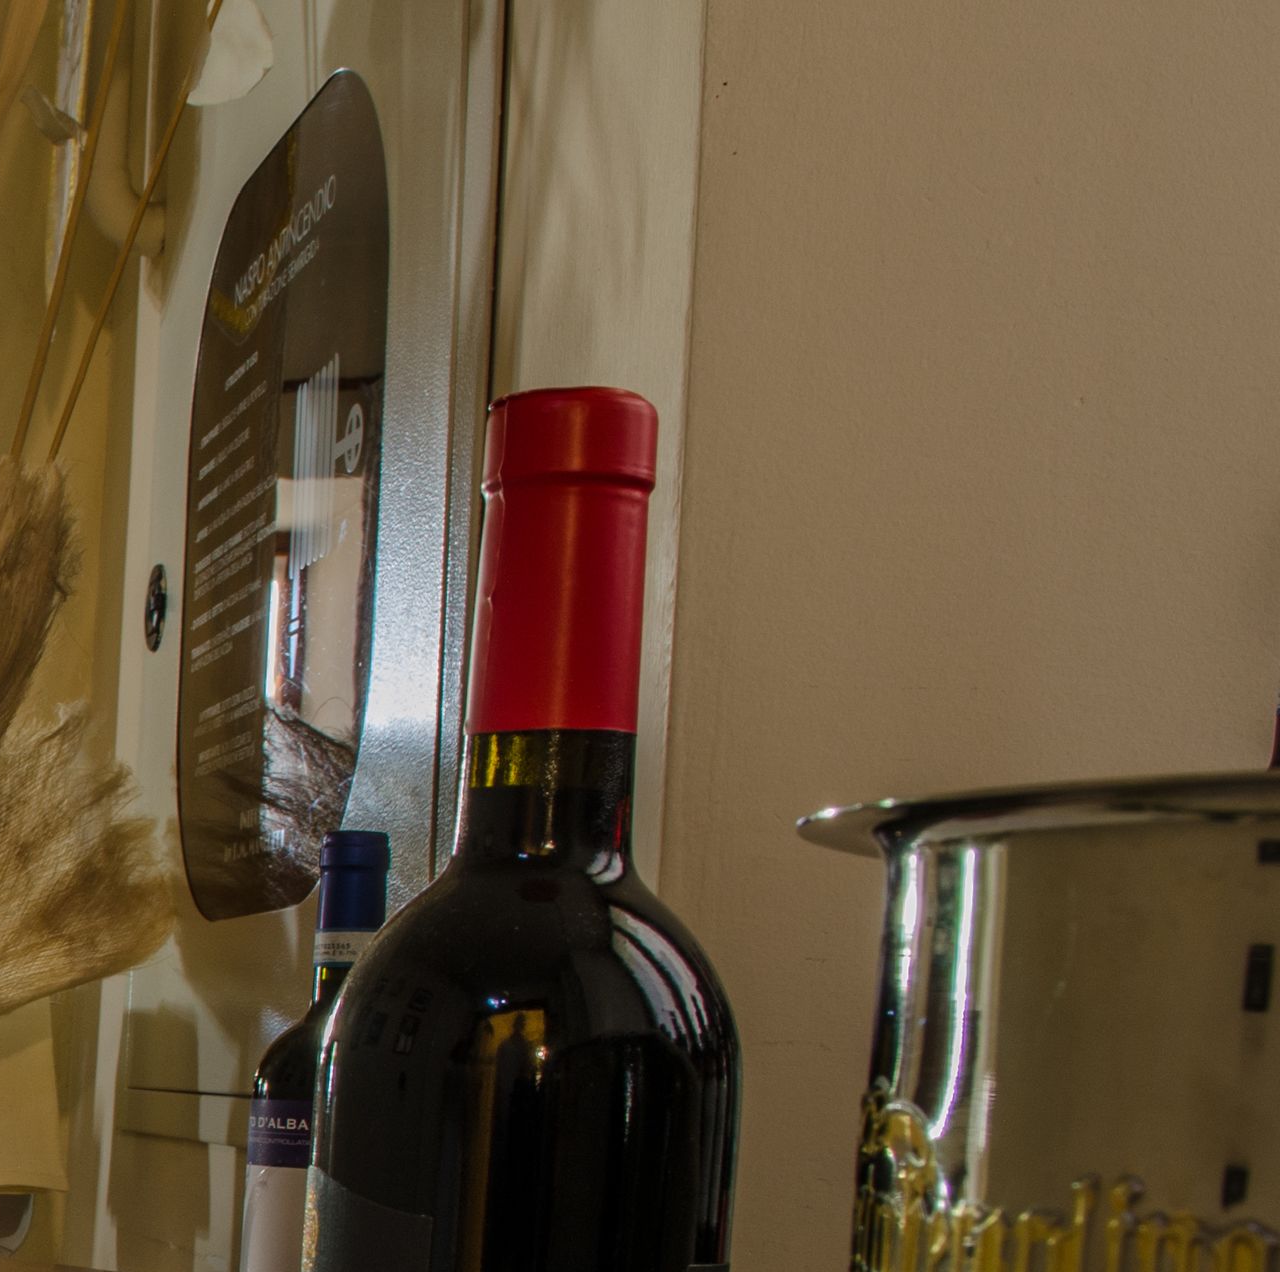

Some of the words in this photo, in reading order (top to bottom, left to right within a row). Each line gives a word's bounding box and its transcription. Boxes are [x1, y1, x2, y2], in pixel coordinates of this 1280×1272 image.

[234, 252, 265, 310] NASPO
[266, 173, 337, 273] ANTINCENDIO
[258, 1116, 309, 1131] D'ALBA
